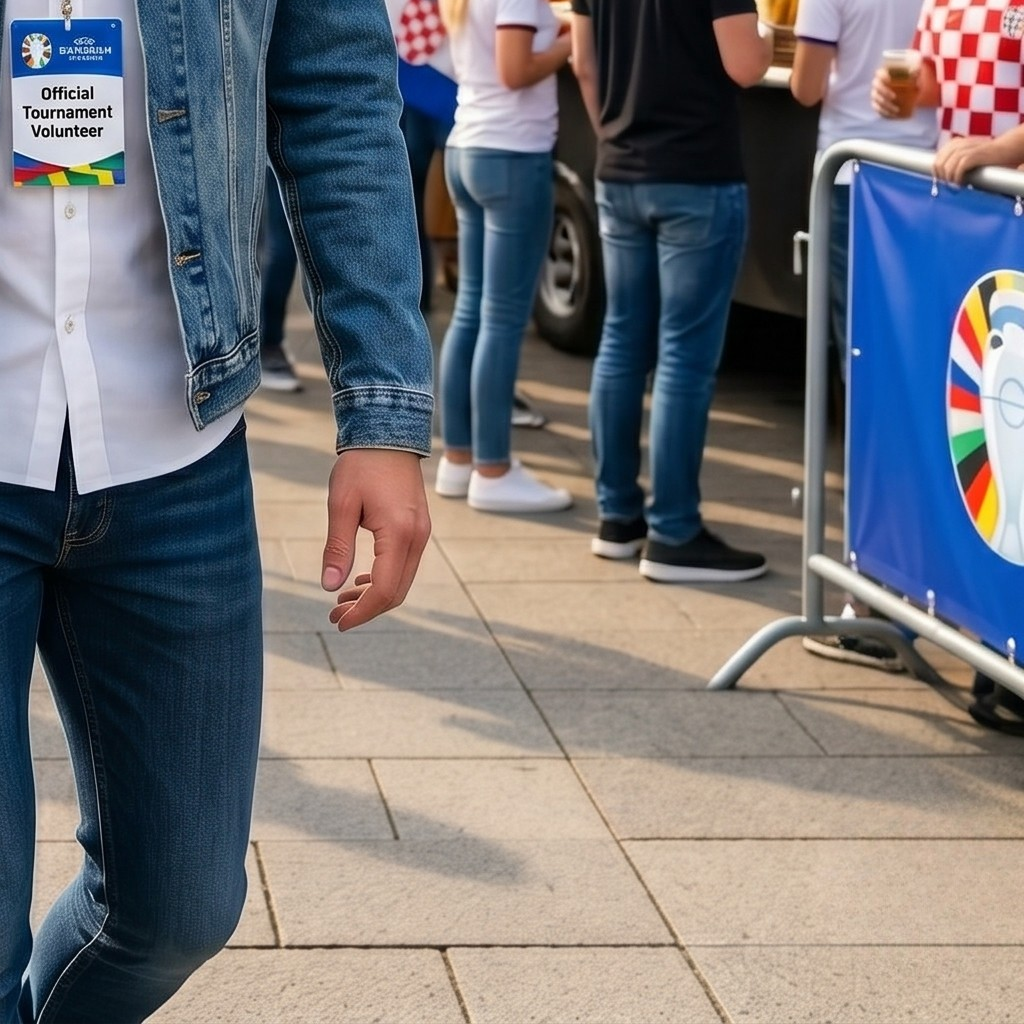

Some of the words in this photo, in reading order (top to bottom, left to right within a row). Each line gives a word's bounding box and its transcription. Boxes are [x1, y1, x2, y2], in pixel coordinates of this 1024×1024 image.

[41, 85, 94, 101] Official
[22, 105, 113, 120] Tournament
[30, 124, 104, 138] Volunteer
